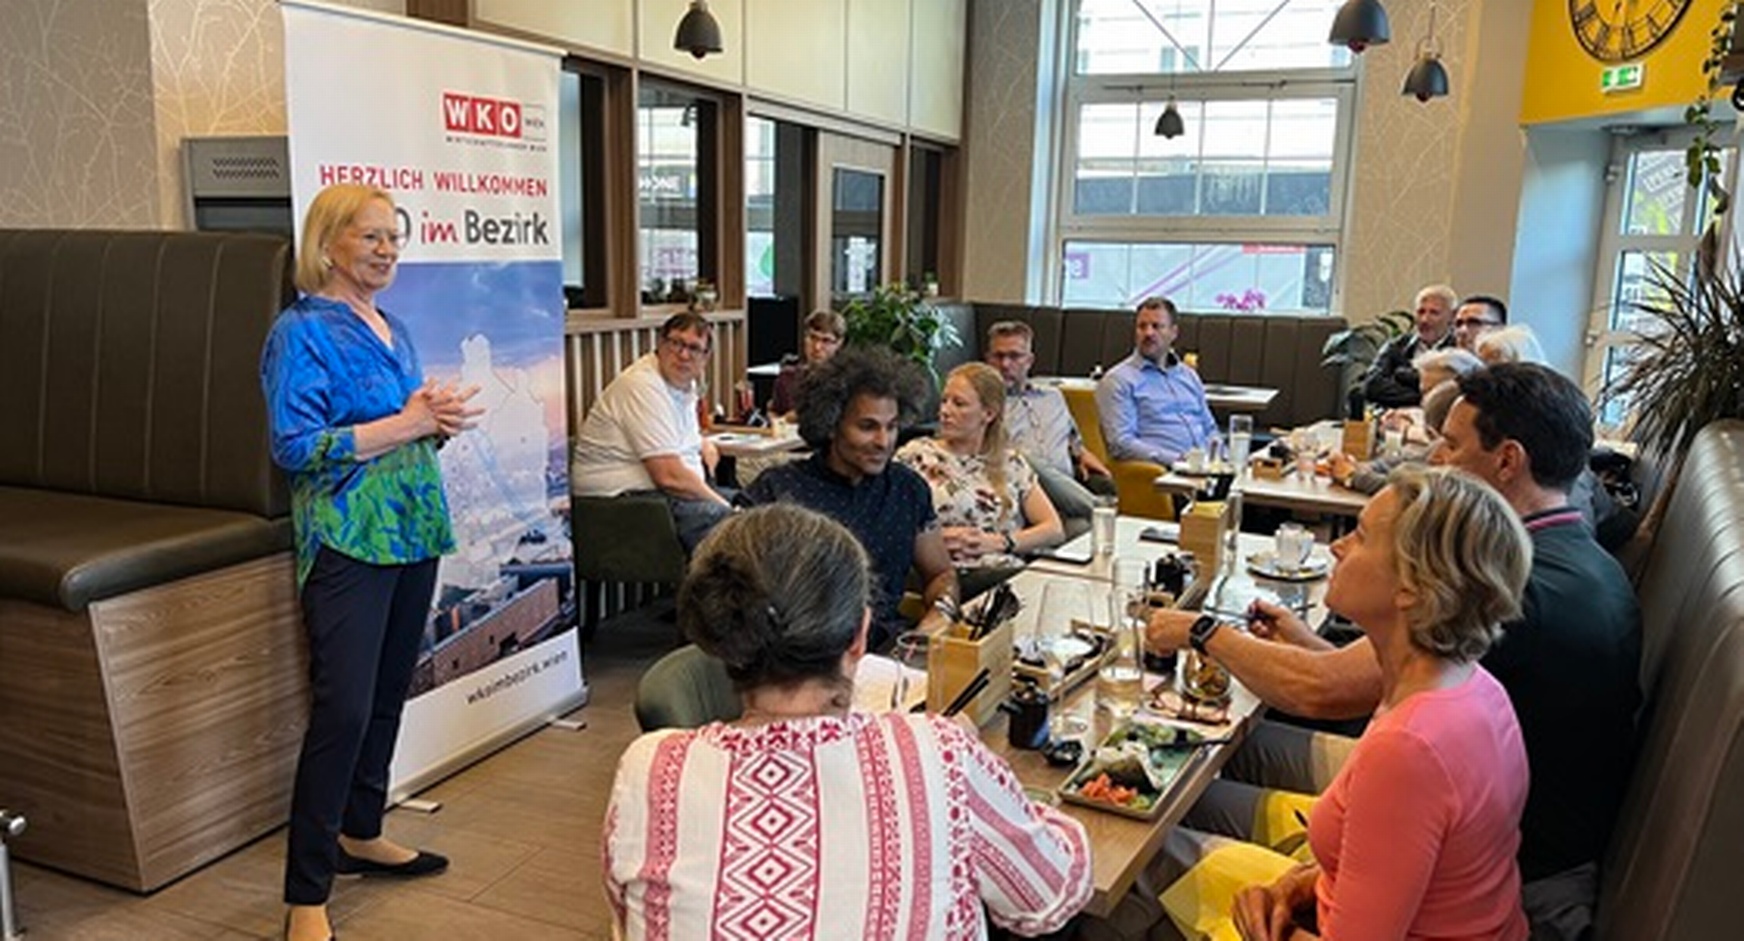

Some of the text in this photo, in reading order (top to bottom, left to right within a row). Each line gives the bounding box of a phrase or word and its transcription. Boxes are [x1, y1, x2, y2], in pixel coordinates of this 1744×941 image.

[445, 98, 518, 134] WKO
[319, 164, 548, 197] HERZLICH WILLKOMMEN
[421, 211, 459, 244] im
[465, 209, 549, 245] Bezirk
